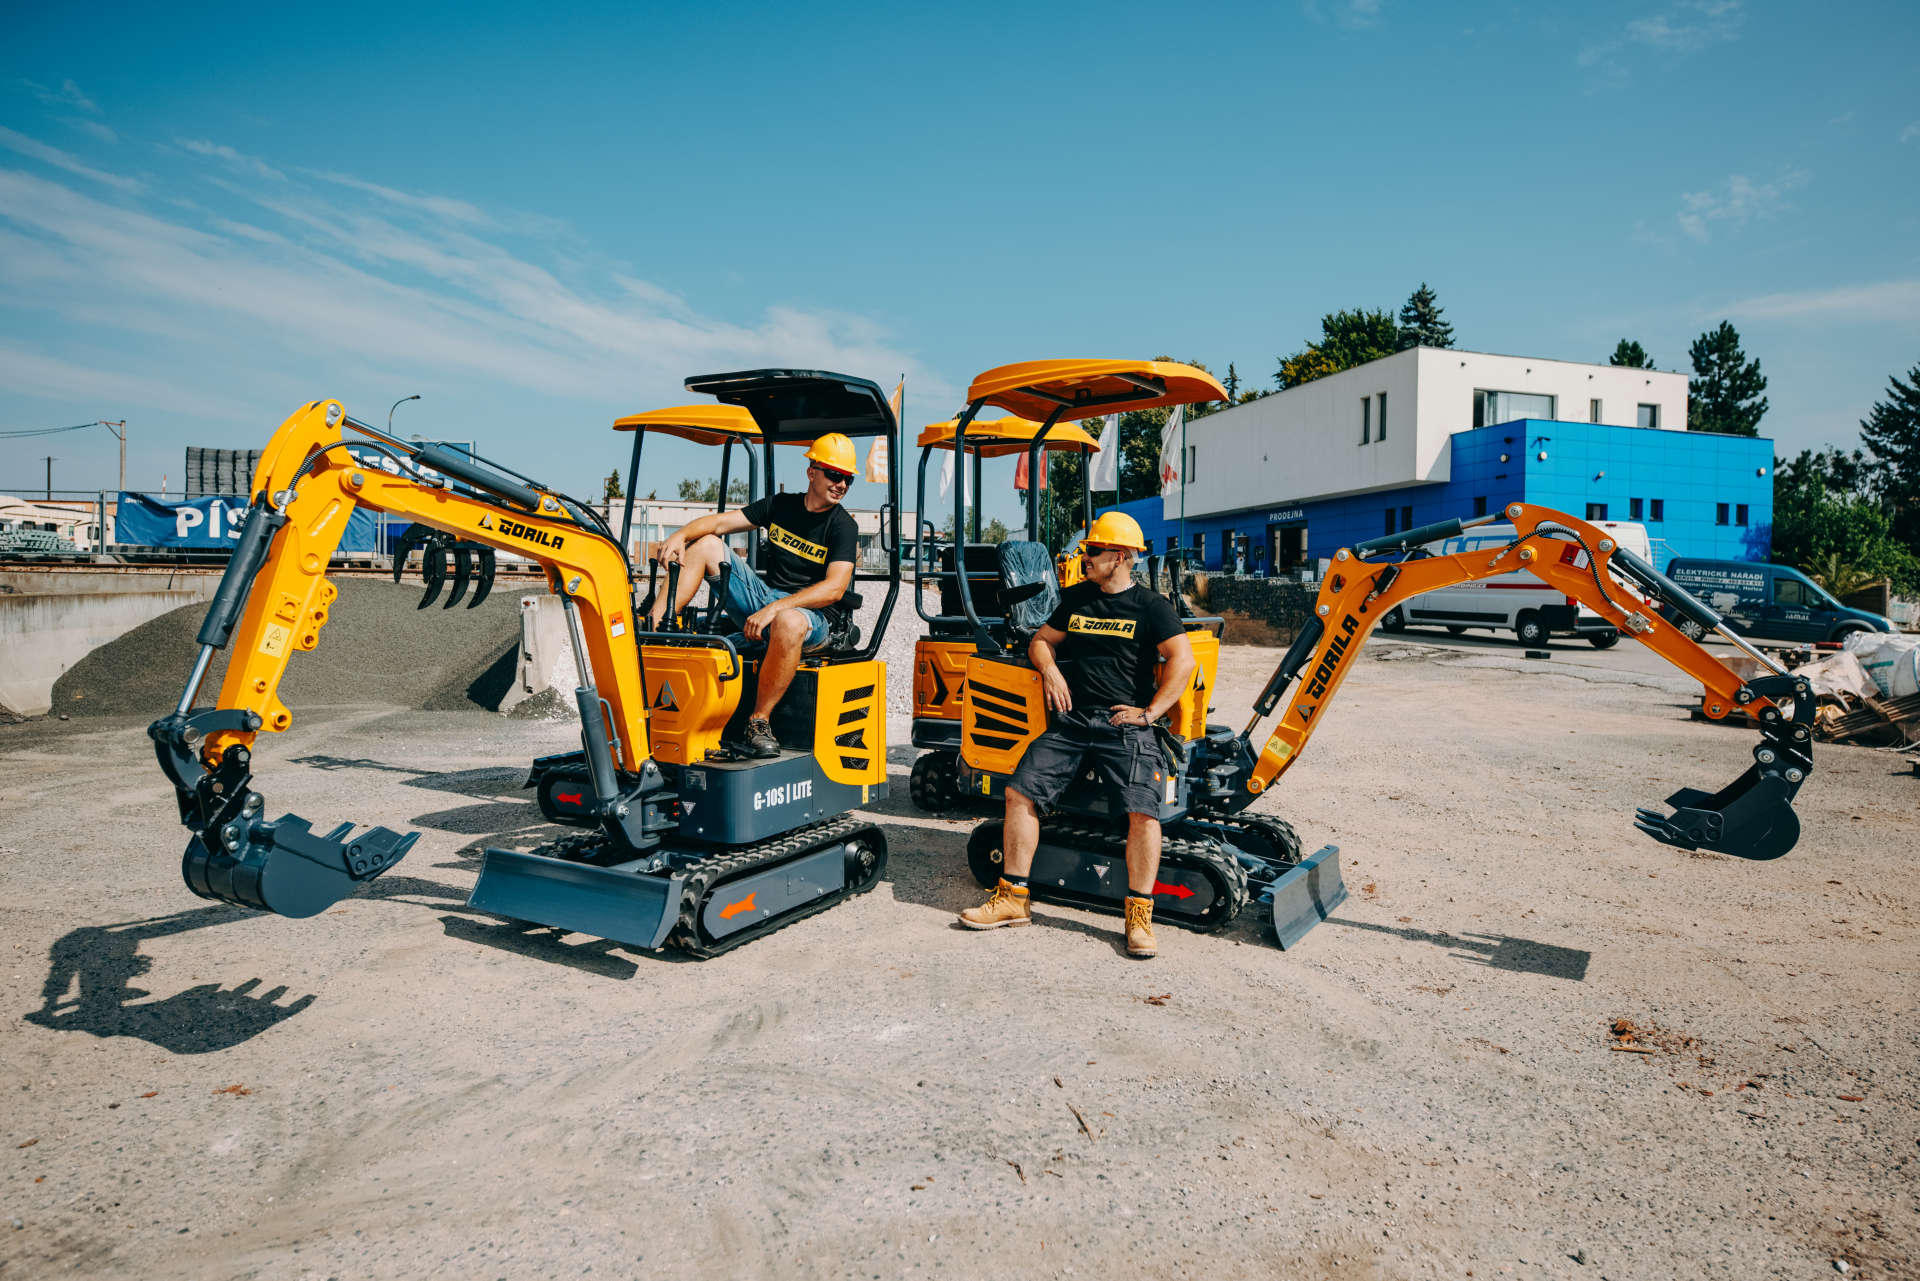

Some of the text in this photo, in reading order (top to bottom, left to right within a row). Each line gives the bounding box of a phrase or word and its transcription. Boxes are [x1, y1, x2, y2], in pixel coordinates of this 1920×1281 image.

[1269, 509, 1303, 521] PRODEJNA
[499, 518, 564, 550] GORILA
[781, 533, 827, 559] GORILA
[1083, 619, 1134, 633] GORILA
[1305, 614, 1359, 700] GORILA
[753, 784, 784, 811] G-10S
[792, 779, 812, 801] LITE
